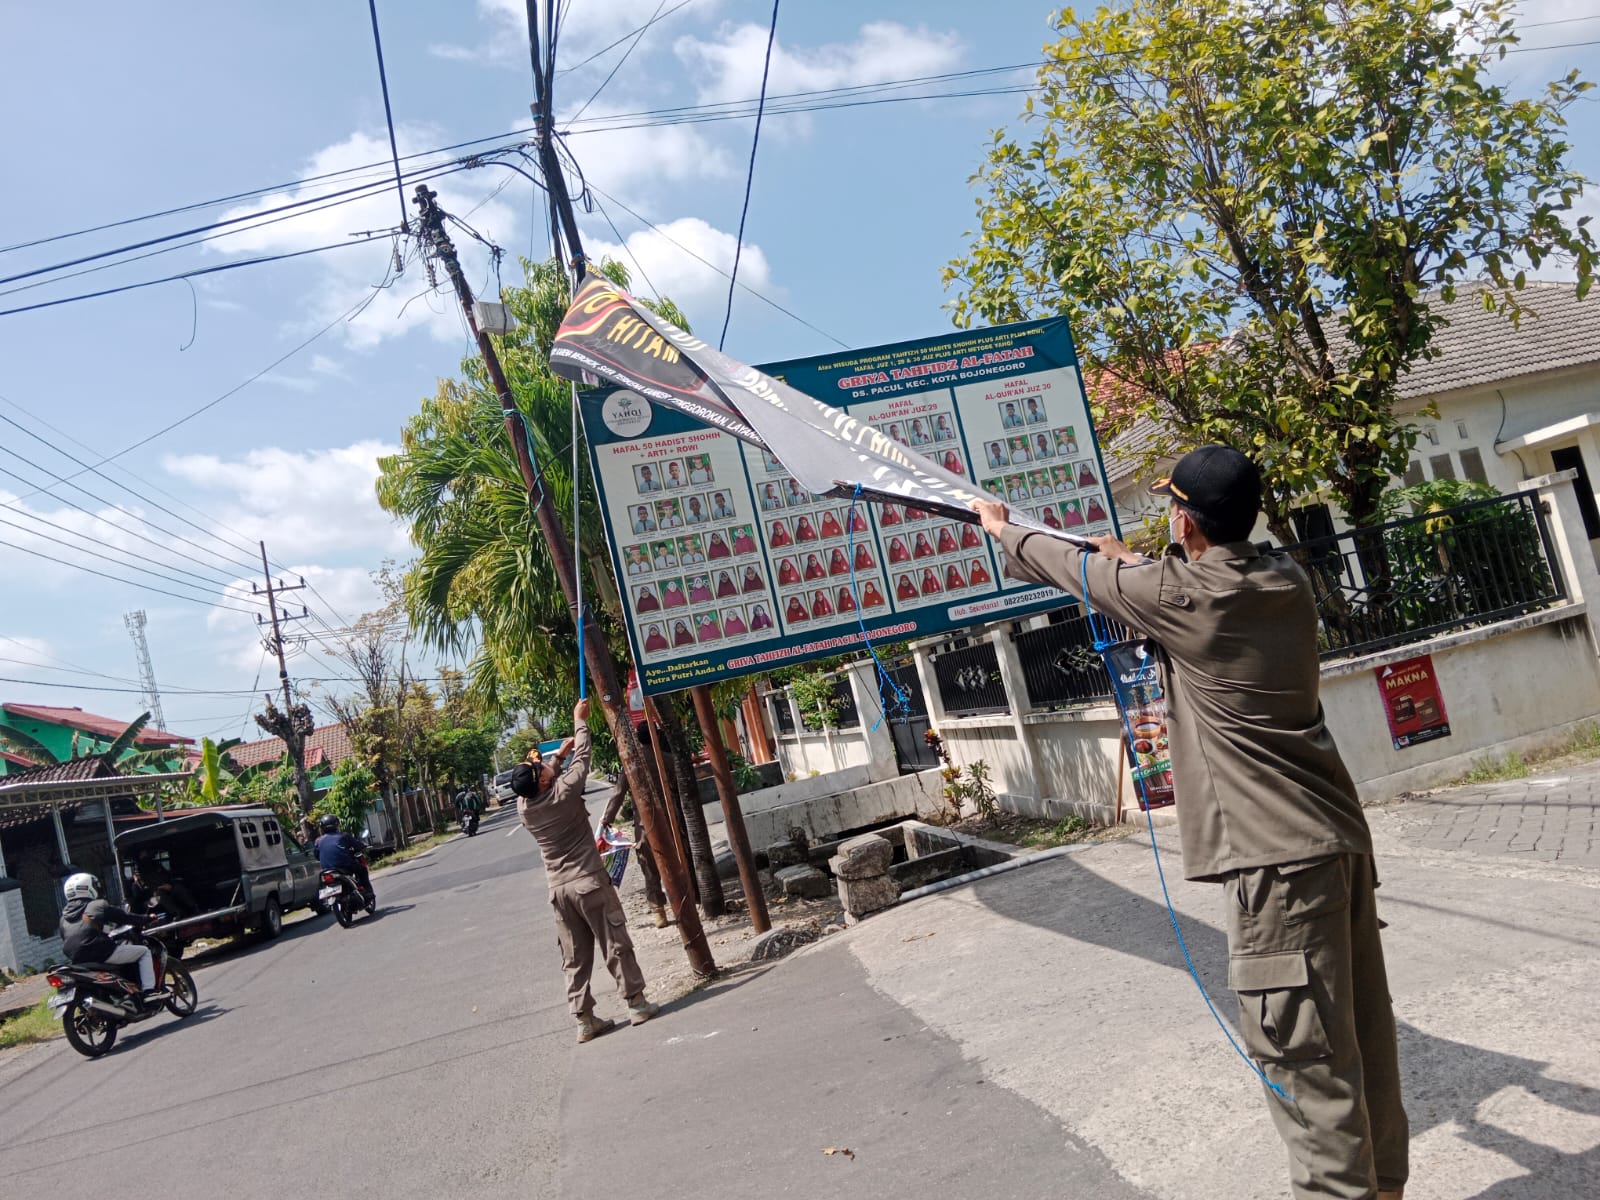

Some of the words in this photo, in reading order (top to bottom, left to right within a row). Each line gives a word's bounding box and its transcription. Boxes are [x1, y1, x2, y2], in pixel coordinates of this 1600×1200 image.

[607, 315, 681, 364] HITAM
[833, 360, 858, 369] WISUDA
[860, 354, 891, 364] PROGRAM
[1011, 331, 1026, 339] PLUS
[838, 372, 889, 390] GRIYA
[890, 359, 959, 380] TAHFIDZ
[961, 346, 1034, 369] AL-FATAH
[854, 365, 875, 373] HAFAL
[852, 389, 869, 398] DS.
[871, 384, 904, 395] PACUL
[906, 379, 929, 389] KEC.
[932, 374, 958, 384] KOTA
[959, 362, 1026, 379] BOJONEGORO
[1004, 379, 1028, 388] HAFAL
[985, 388, 1025, 401] AL-QUR'AN
[1026, 385, 1041, 393] JUZ
[1042, 383, 1052, 391] 30
[612, 409, 642, 419] YAHQI
[868, 409, 910, 422] AL-QUR'AN
[911, 406, 926, 414] JUZ
[926, 403, 938, 412] 29
[888, 400, 914, 409] HAFAL
[612, 445, 641, 455] HAFAL
[642, 442, 653, 450] 50
[655, 437, 686, 448] HADIST
[688, 432, 721, 443] SHOHIH
[647, 449, 667, 458] ARTI
[677, 444, 699, 454] ROWI
[727, 656, 755, 670] GRIYA
[755, 649, 791, 664] TAHFIZH
[791, 638, 832, 656] AL-FATAH
[832, 633, 860, 648] PACUL
[859, 621, 918, 642] BOJONEGORO
[647, 675, 671, 686] Putra
[671, 671, 694, 682] Putri
[695, 667, 716, 676] Anda
[716, 664, 725, 672] di
[1385, 670, 1429, 690] MAKNA
